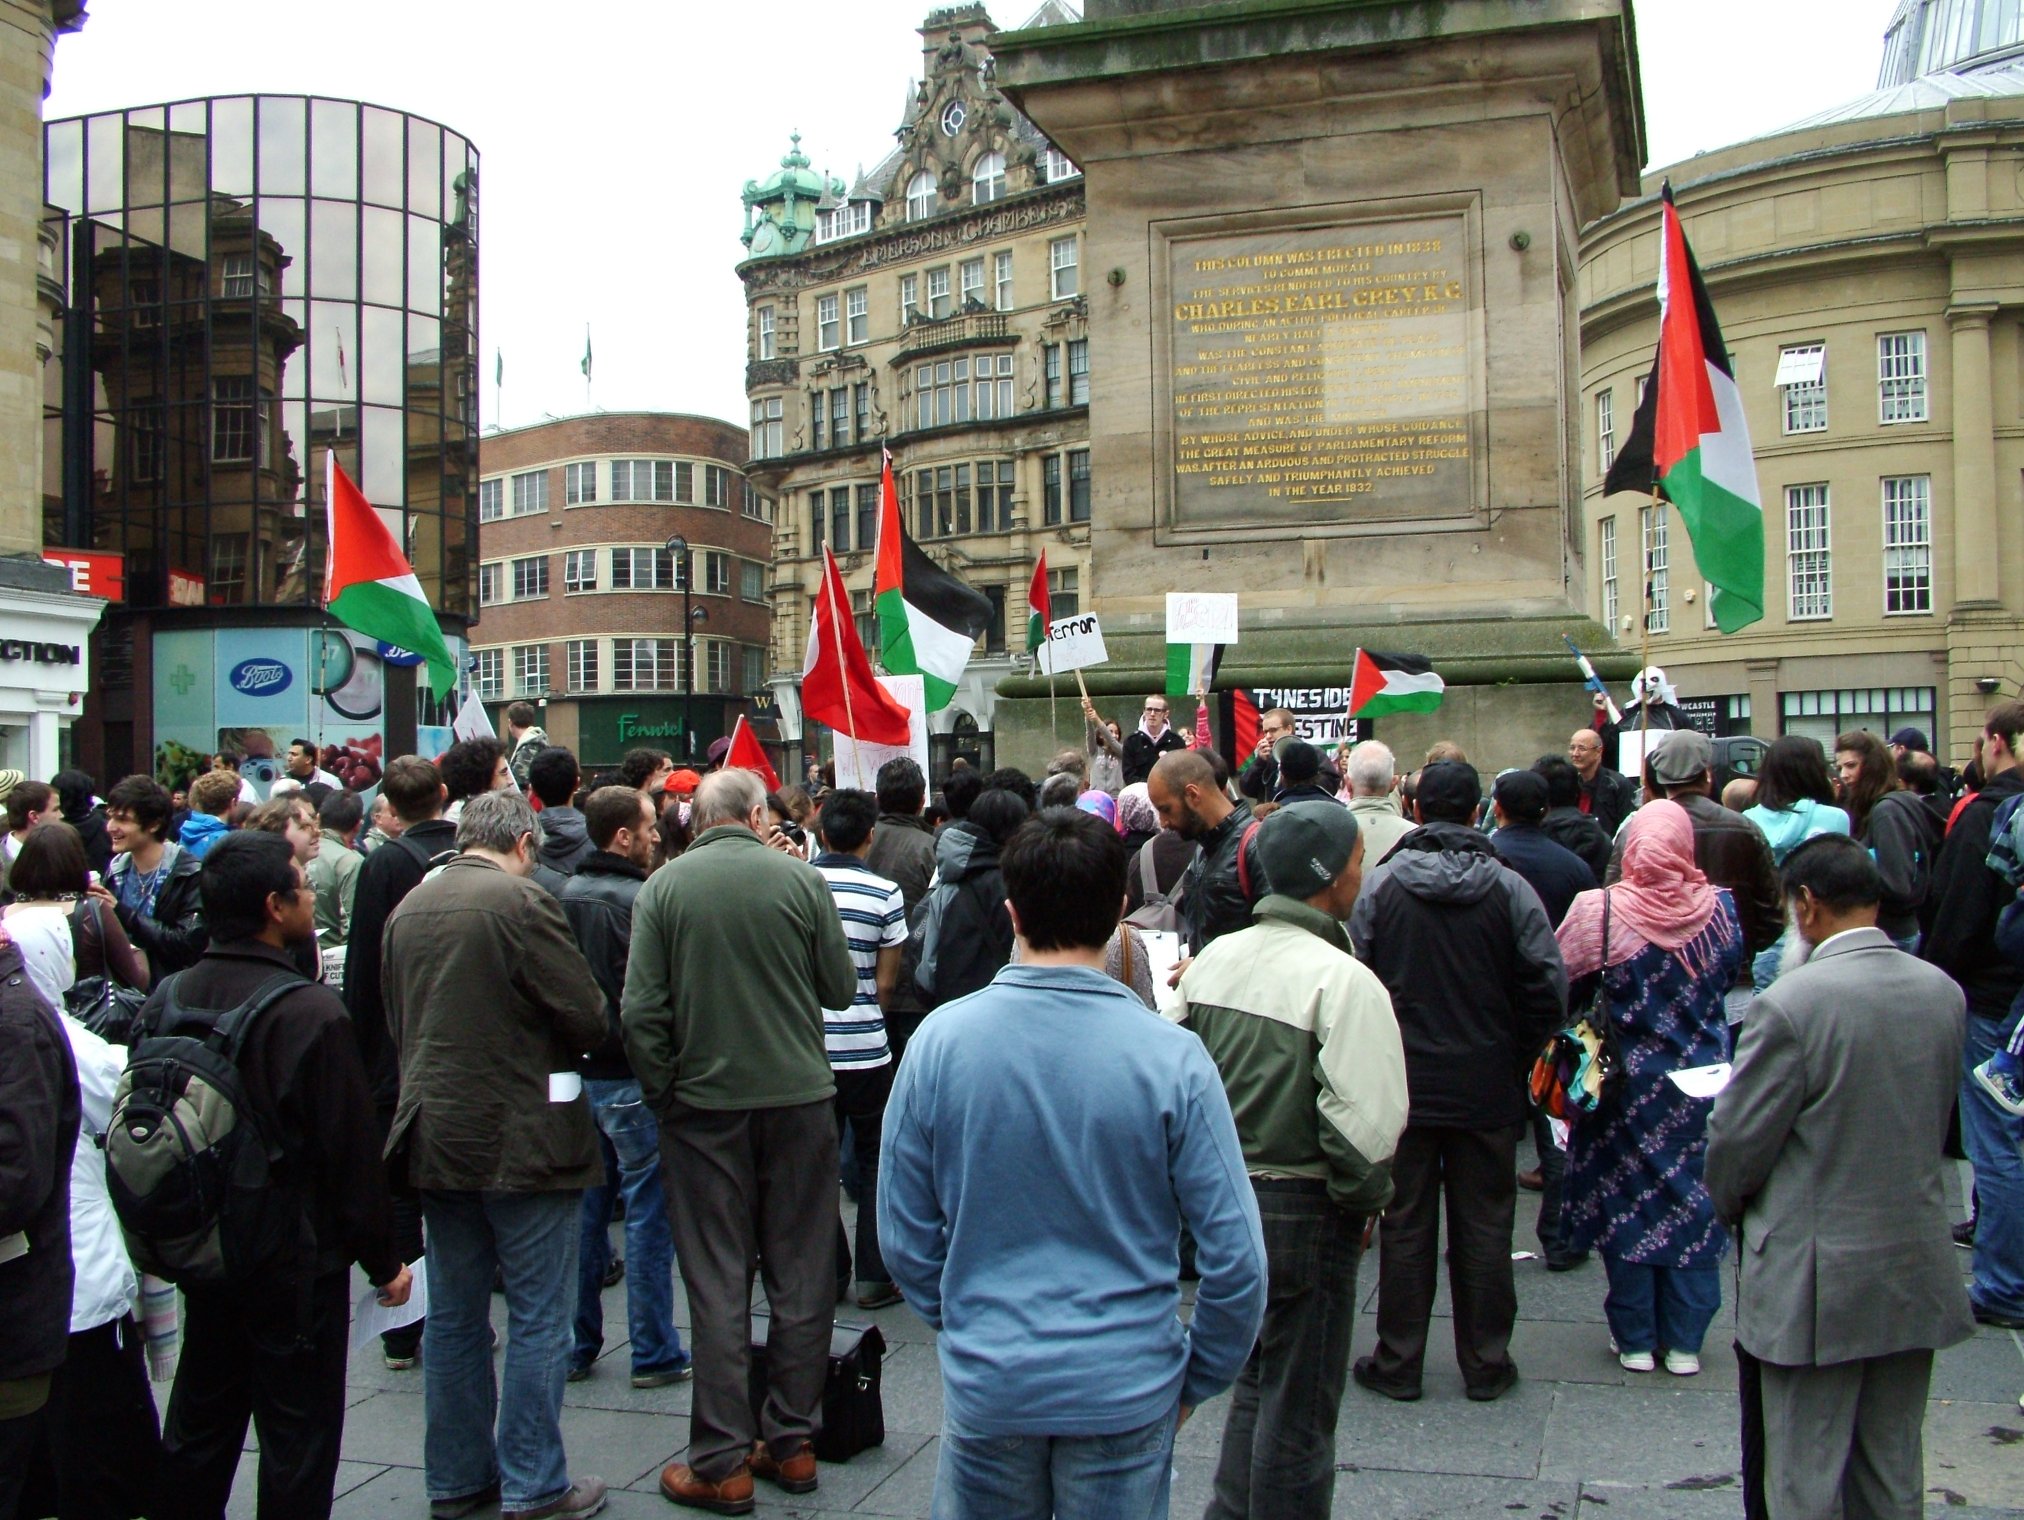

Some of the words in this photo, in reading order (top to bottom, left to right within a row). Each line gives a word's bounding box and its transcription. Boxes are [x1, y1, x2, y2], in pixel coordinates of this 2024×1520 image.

[861, 229, 943, 267] EMERSON
[962, 200, 1068, 242] CHAMBERS
[1195, 257, 1224, 271] THIS
[1228, 254, 1283, 268] COLUMN
[1286, 250, 1314, 264] WAS
[1317, 244, 1384, 260] ERECTED
[1388, 243, 1403, 255] IN
[1263, 270, 1277, 279] TO
[1280, 261, 1372, 279] COMMEMORATE
[1193, 288, 1212, 298] THE
[1274, 278, 1333, 291] RENDERED
[1337, 276, 1350, 287] TO
[1353, 275, 1373, 287] HIS
[1375, 270, 1428, 283] COUNTRY
[1432, 268, 1448, 280] BY
[1286, 291, 1349, 311] EARL
[1219, 317, 1259, 331] DURING
[1263, 316, 1277, 328] AN
[1280, 315, 1316, 325] ACTIVE
[1321, 308, 1378, 324] POLITICAL
[1384, 304, 1430, 317] CAREER
[1243, 330, 1289, 344] NEARLY
[1293, 326, 1322, 340] HALF
[1198, 350, 1223, 361] WAS
[1226, 348, 1247, 359] THE
[1251, 343, 1312, 358] CONSTANT
[1175, 364, 1198, 376] AND
[1200, 362, 1218, 375] THE
[1222, 359, 1280, 373] FEARLESS
[1283, 356, 1306, 368] AND
[1232, 375, 1260, 386] CIVIL
[1265, 373, 1288, 384] AND
[1175, 395, 1187, 404] HE
[1191, 391, 1221, 403] FIRST
[1225, 387, 1279, 401] DIRECTED
[1281, 384, 1299, 397] HIS
[1180, 407, 1194, 418] OF
[1199, 404, 1220, 416] THE
[1223, 398, 1325, 415] REPRESENTATION
[1247, 417, 1271, 427] AND
[1275, 415, 1300, 426] WAS
[1304, 413, 1325, 424] THE
[1180, 435, 1197, 446] BY
[1200, 431, 1240, 444] WHOSE
[1289, 427, 1313, 439] AND
[1315, 425, 1353, 437] UNDER
[1357, 422, 1399, 435] WHOSE
[1179, 449, 1200, 460] THE
[1203, 446, 1240, 459] GREAT
[1243, 442, 1297, 456] MEASURE
[1300, 440, 1314, 453] OF
[1317, 435, 1415, 451] PARLIAMENTARY
[1418, 433, 1468, 446] REFORM
[1201, 460, 1237, 473] AFTER
[1239, 459, 1254, 470] AN
[1256, 456, 1310, 470] ARDUOUS
[1311, 453, 1335, 466] AND
[1336, 450, 1410, 465] PROTRACTED
[1412, 447, 1470, 461] STRUGGLE
[1209, 474, 1254, 486] SAFELY
[1257, 472, 1281, 484] AND
[1284, 467, 1373, 482] TRIUMPHANTLY
[1375, 463, 1436, 478] ACHIEVED
[1268, 486, 1281, 497] IN
[1284, 485, 1306, 497] THE
[1311, 483, 1342, 495] YEAR
[236, 664, 284, 689] Boots
[754, 696, 770, 709] W
[1252, 687, 1351, 709] TYNESIDE
[1677, 701, 1716, 710] WCASTLE
[1294, 717, 1357, 739] ESTINE
